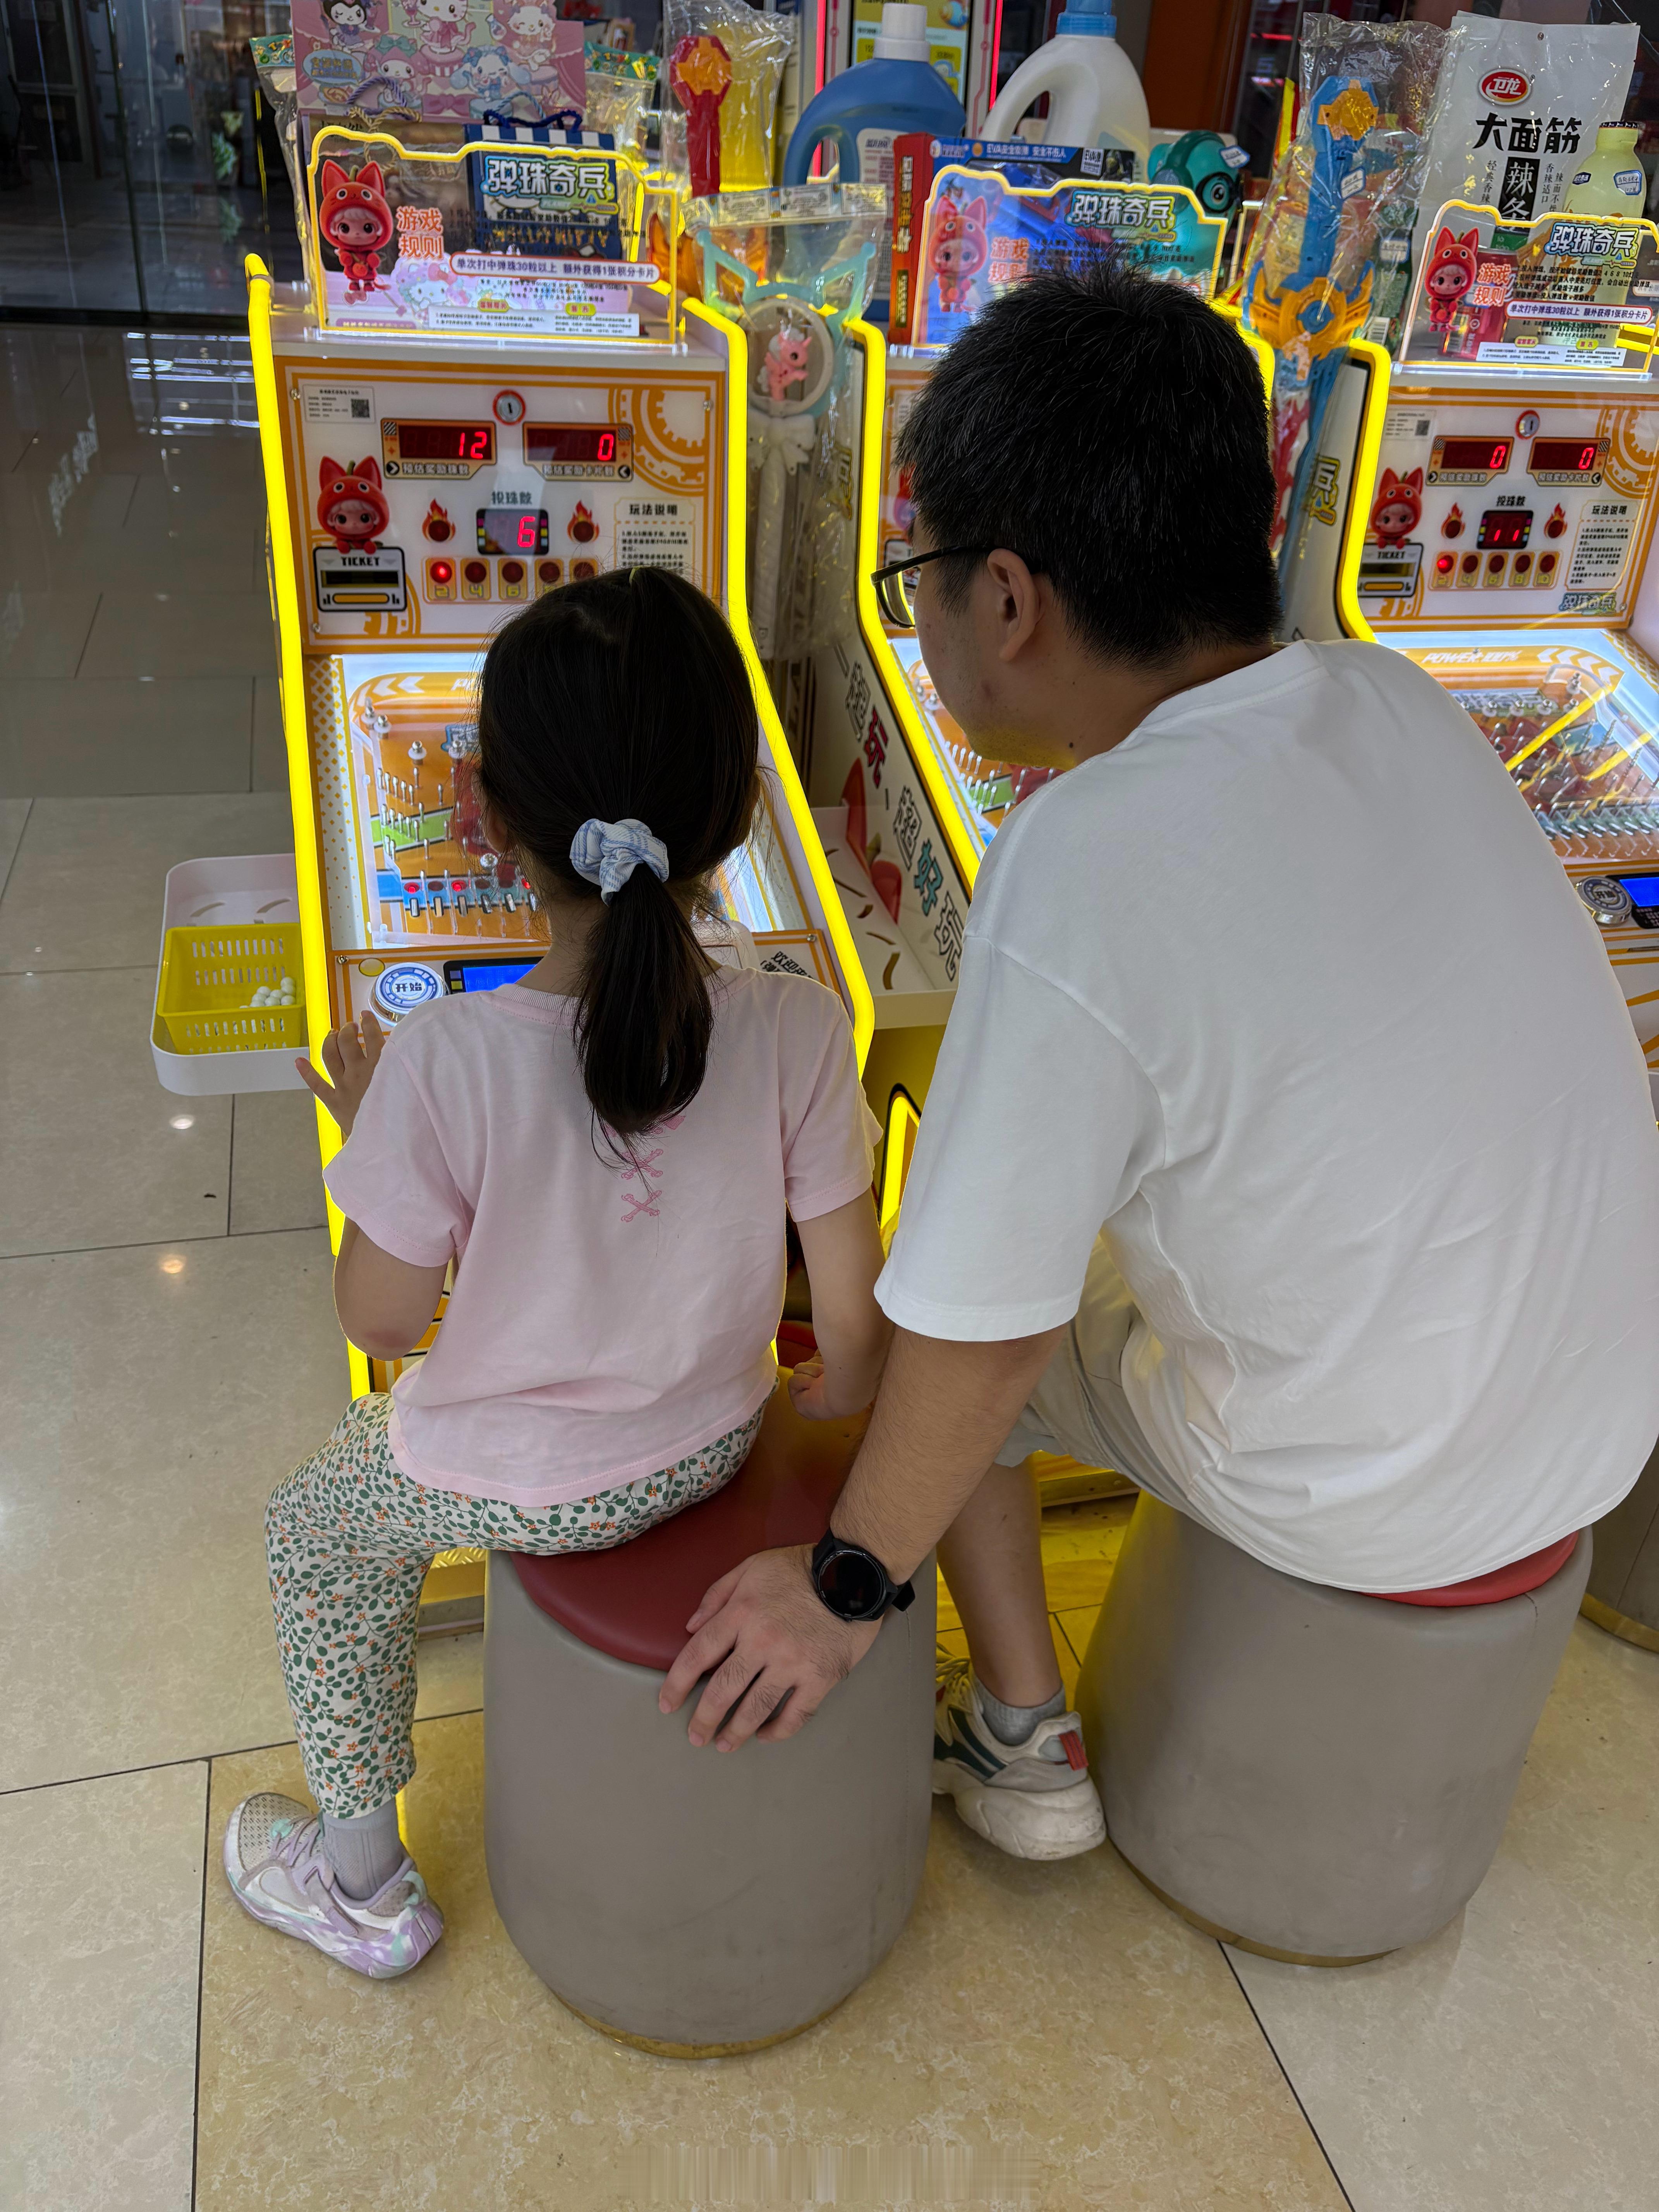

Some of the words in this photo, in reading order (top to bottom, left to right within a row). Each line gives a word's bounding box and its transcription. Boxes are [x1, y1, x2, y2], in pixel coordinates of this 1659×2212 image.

[1486, 76, 1522, 96] 卫龙
[1472, 112, 1582, 154] 大面筋
[488, 160, 606, 199] 弹珠奇兵
[1480, 160, 1497, 203] 经典香辣
[1541, 163, 1554, 203] 香辣适口
[1501, 161, 1535, 230] 辣条
[395, 206, 443, 234] 游戏
[1072, 195, 1171, 228] 弹珠奇兵
[398, 234, 444, 260] 规则
[991, 236, 1029, 261] 游戏
[1551, 225, 1637, 257] 弹珠奇兵
[457, 258, 557, 273] 单次打中弹珠30粒以上
[563, 263, 655, 280] 额外获得1张积分卡片
[988, 261, 1028, 283] 规则
[1477, 263, 1511, 285] 游戏
[1472, 285, 1507, 307] 规则
[1511, 304, 1580, 316] 单次打中弹珠30粒以上
[1583, 306, 1648, 320] 额外获得1张积分卡片
[459, 431, 487, 459] 12
[597, 433, 614, 461] 0
[1489, 445, 1506, 469] 0
[1578, 447, 1595, 470] 0
[491, 491, 532, 504] 投珠数
[1496, 495, 1526, 507] 投珠数
[629, 503, 678, 515] 玩法说明
[1591, 505, 1627, 515] 玩法说明
[517, 516, 536, 548] 6
[341, 556, 380, 567] TICKET
[1377, 551, 1406, 559] TICKET
[434, 586, 450, 598] 2
[469, 585, 484, 598] 4
[507, 585, 522, 598] 6
[1421, 652, 1484, 664] POWER
[395, 981, 422, 993] 开始
